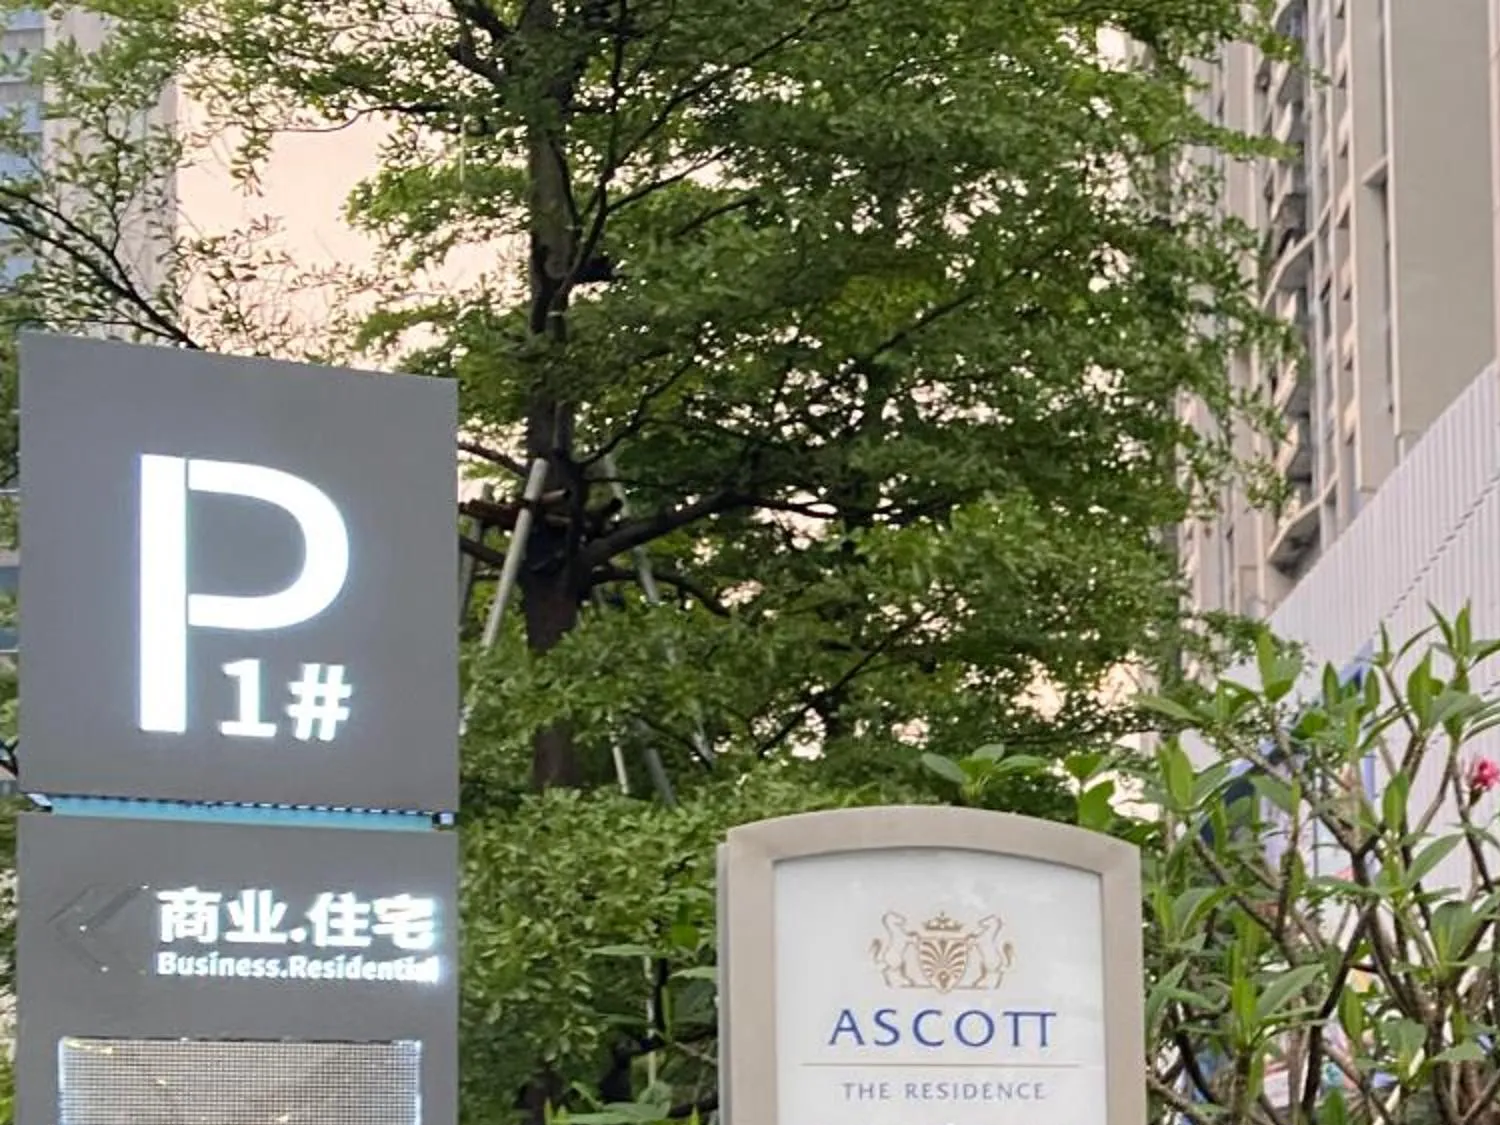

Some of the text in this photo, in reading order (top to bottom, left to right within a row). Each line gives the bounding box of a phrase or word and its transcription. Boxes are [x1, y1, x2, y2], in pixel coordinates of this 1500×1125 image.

[138, 453, 350, 734] P
[218, 657, 352, 741] 1#
[828, 1008, 1057, 1048] ASCOTT
[842, 1081, 1047, 1101] THE RESIDENCE
